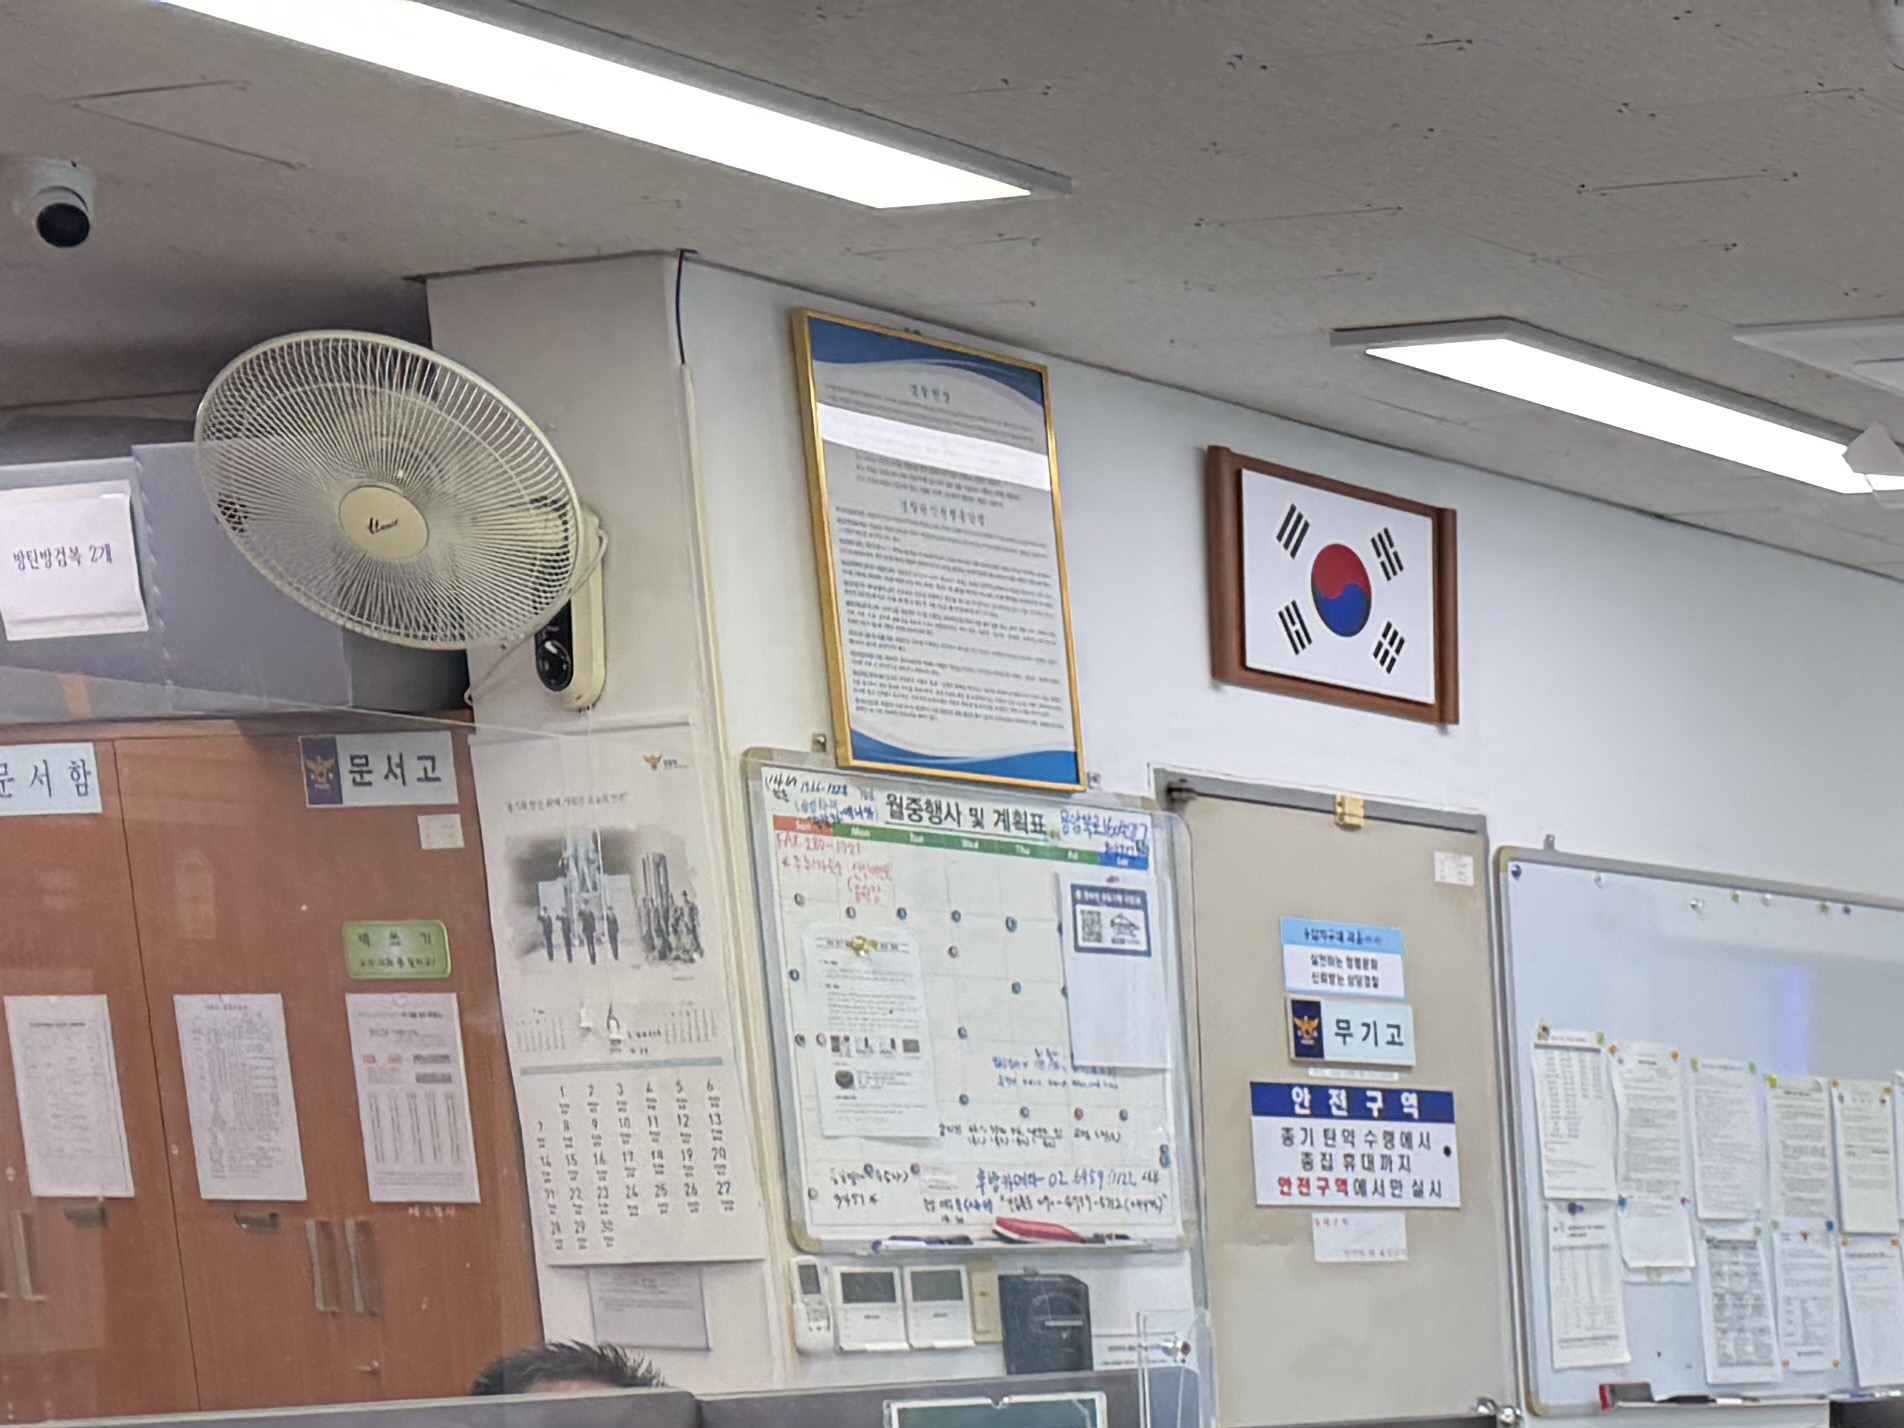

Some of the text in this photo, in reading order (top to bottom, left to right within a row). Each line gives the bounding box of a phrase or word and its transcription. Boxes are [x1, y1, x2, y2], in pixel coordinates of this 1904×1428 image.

[349, 753, 442, 788] 문서고
[885, 793, 960, 828] 월중행사
[969, 807, 985, 828] 및
[993, 808, 1047, 836] 계획표
[1334, 1018, 1404, 1048] 무기고
[1292, 1086, 1420, 1120] 안전구역
[1281, 1127, 1315, 1148] 총기
[1343, 1153, 1412, 1174] 휴대까지
[1278, 1176, 1442, 1200] 안전구역에서만 실시
